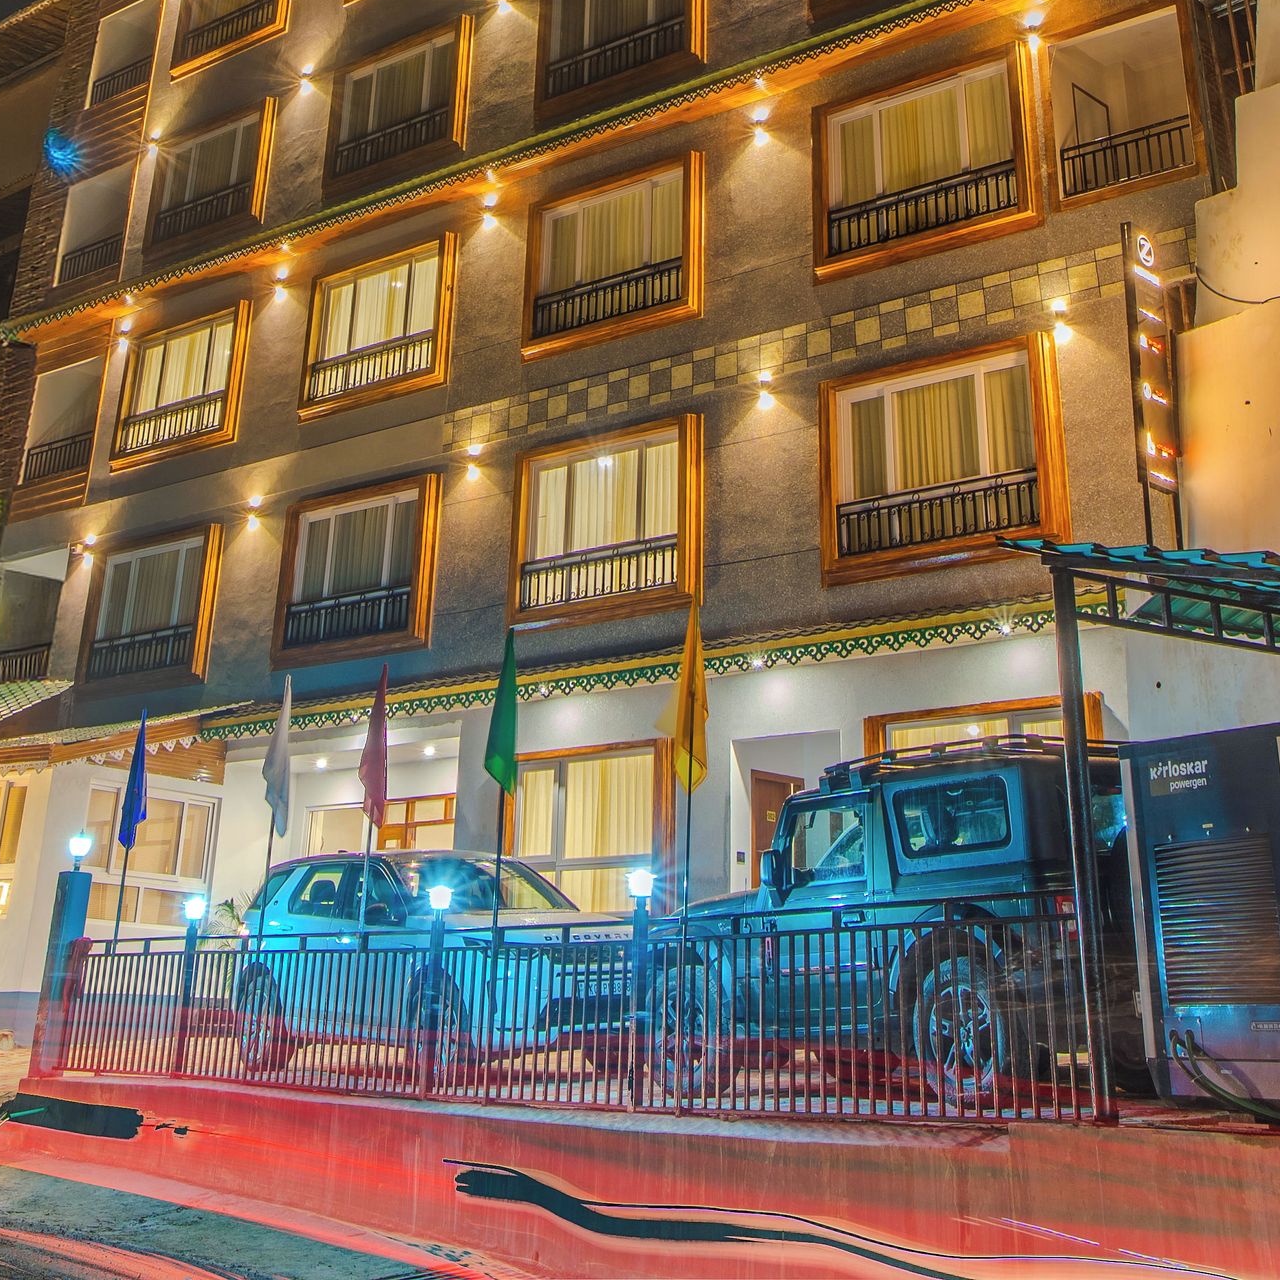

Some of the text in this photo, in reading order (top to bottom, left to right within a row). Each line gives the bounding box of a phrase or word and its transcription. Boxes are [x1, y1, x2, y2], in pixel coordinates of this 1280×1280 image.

[1150, 760, 1208, 780] kirloskar
[1170, 778, 1208, 793] powergen
[544, 932, 629, 942] DICOVERY
